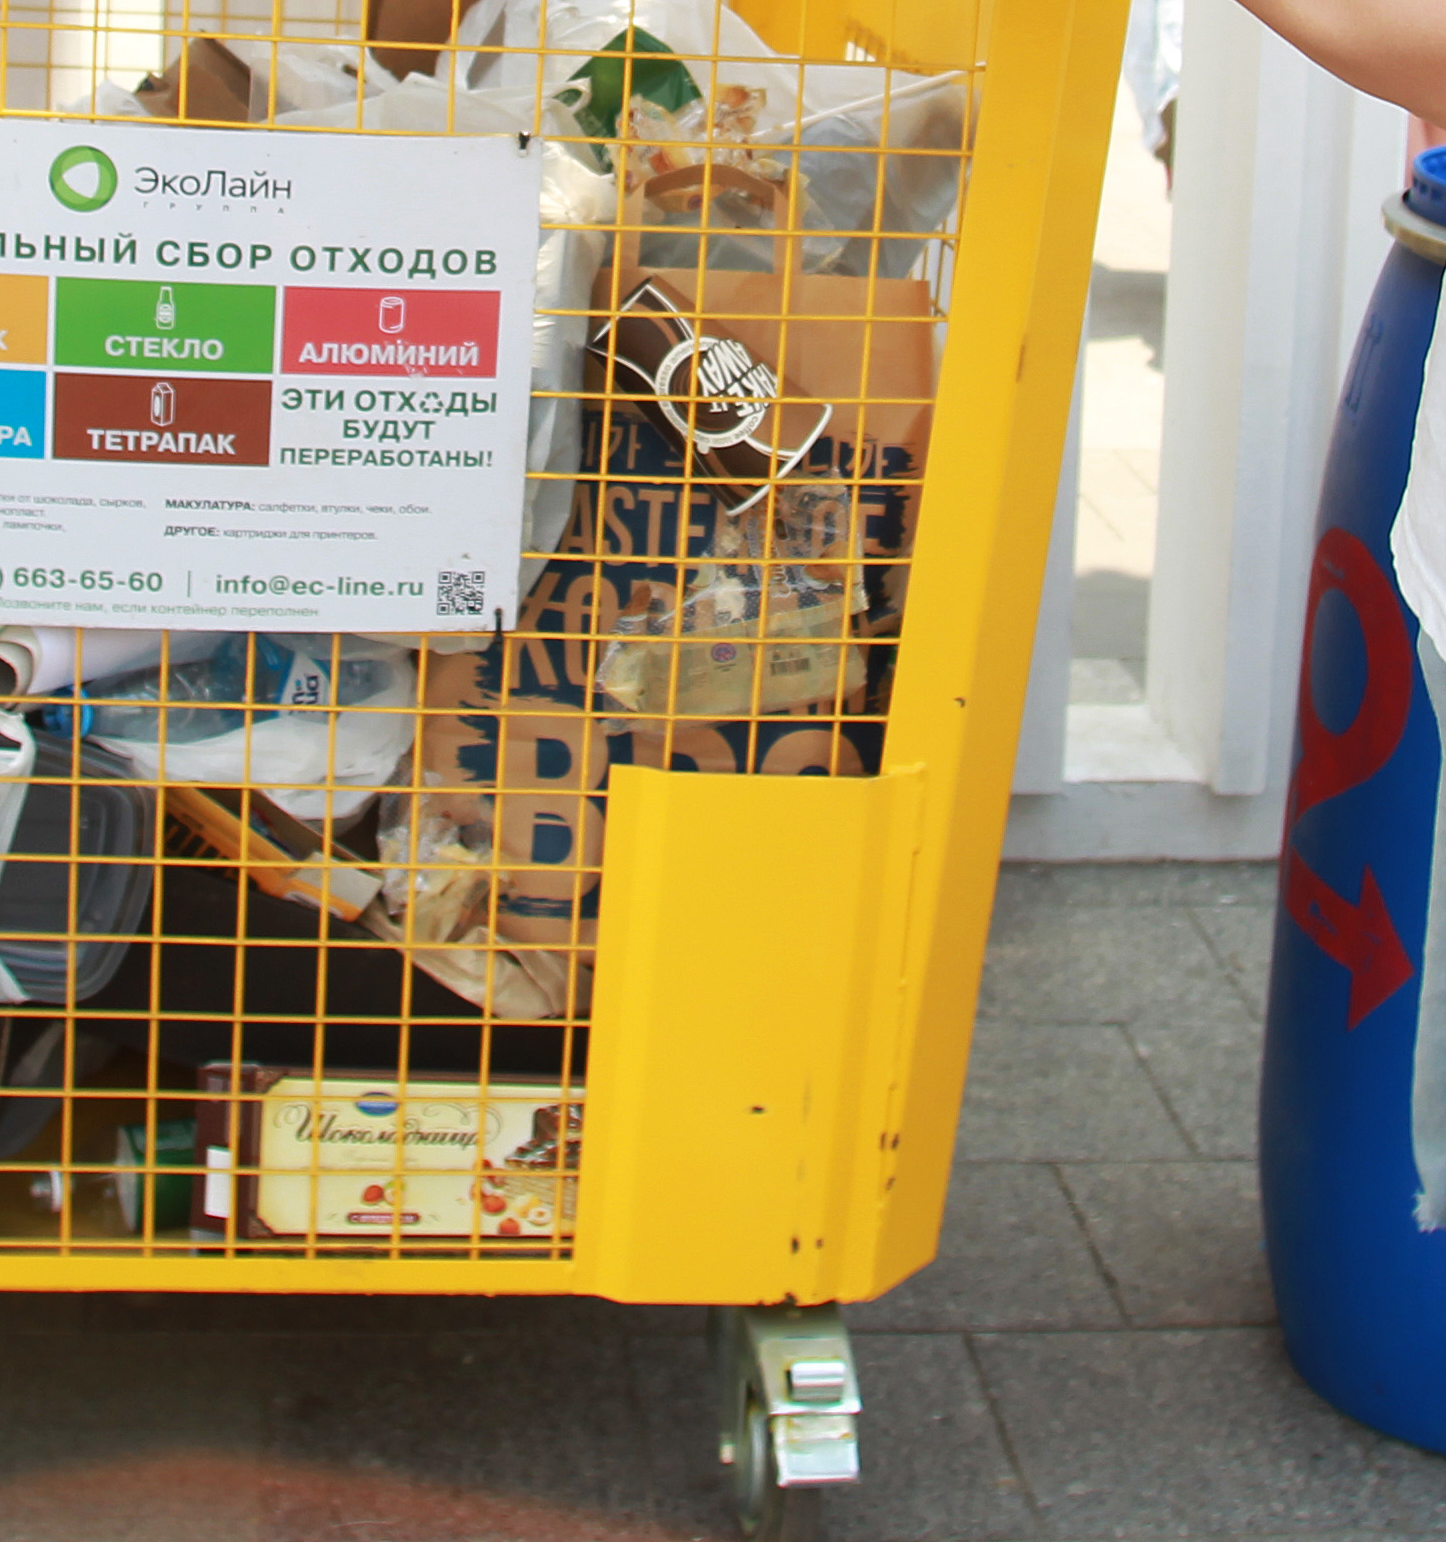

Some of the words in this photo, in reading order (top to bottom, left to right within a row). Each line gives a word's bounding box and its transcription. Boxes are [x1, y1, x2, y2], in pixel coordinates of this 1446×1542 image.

[133, 167, 292, 200] ЭкоЛайн
[142, 201, 285, 215] ГРУППА
[155, 240, 274, 270] СБОР
[289, 245, 498, 280] ОТХОДОВ
[104, 334, 225, 362] СТЕКЛО
[298, 341, 480, 367] АЛЮМИНИЙ
[281, 389, 344, 411] ЭТИ
[86, 428, 237, 456] ТЕТРАПАК
[342, 419, 436, 443] БУДУТ
[280, 447, 493, 468] ПЕРЕРАБОТАНЫ!
[164, 499, 256, 512] МАКУЛАТУРА:
[164, 526, 220, 538] ДРУГОЕ:
[223, 528, 287, 540] картриджи
[13, 567, 164, 592] 663-65-60
[216, 574, 424, 598] info@ec-line.ru
[75, 600, 107, 613] нам,
[111, 603, 147, 614] если
[150, 604, 227, 618] контейнер
[231, 607, 319, 619] переполнен
